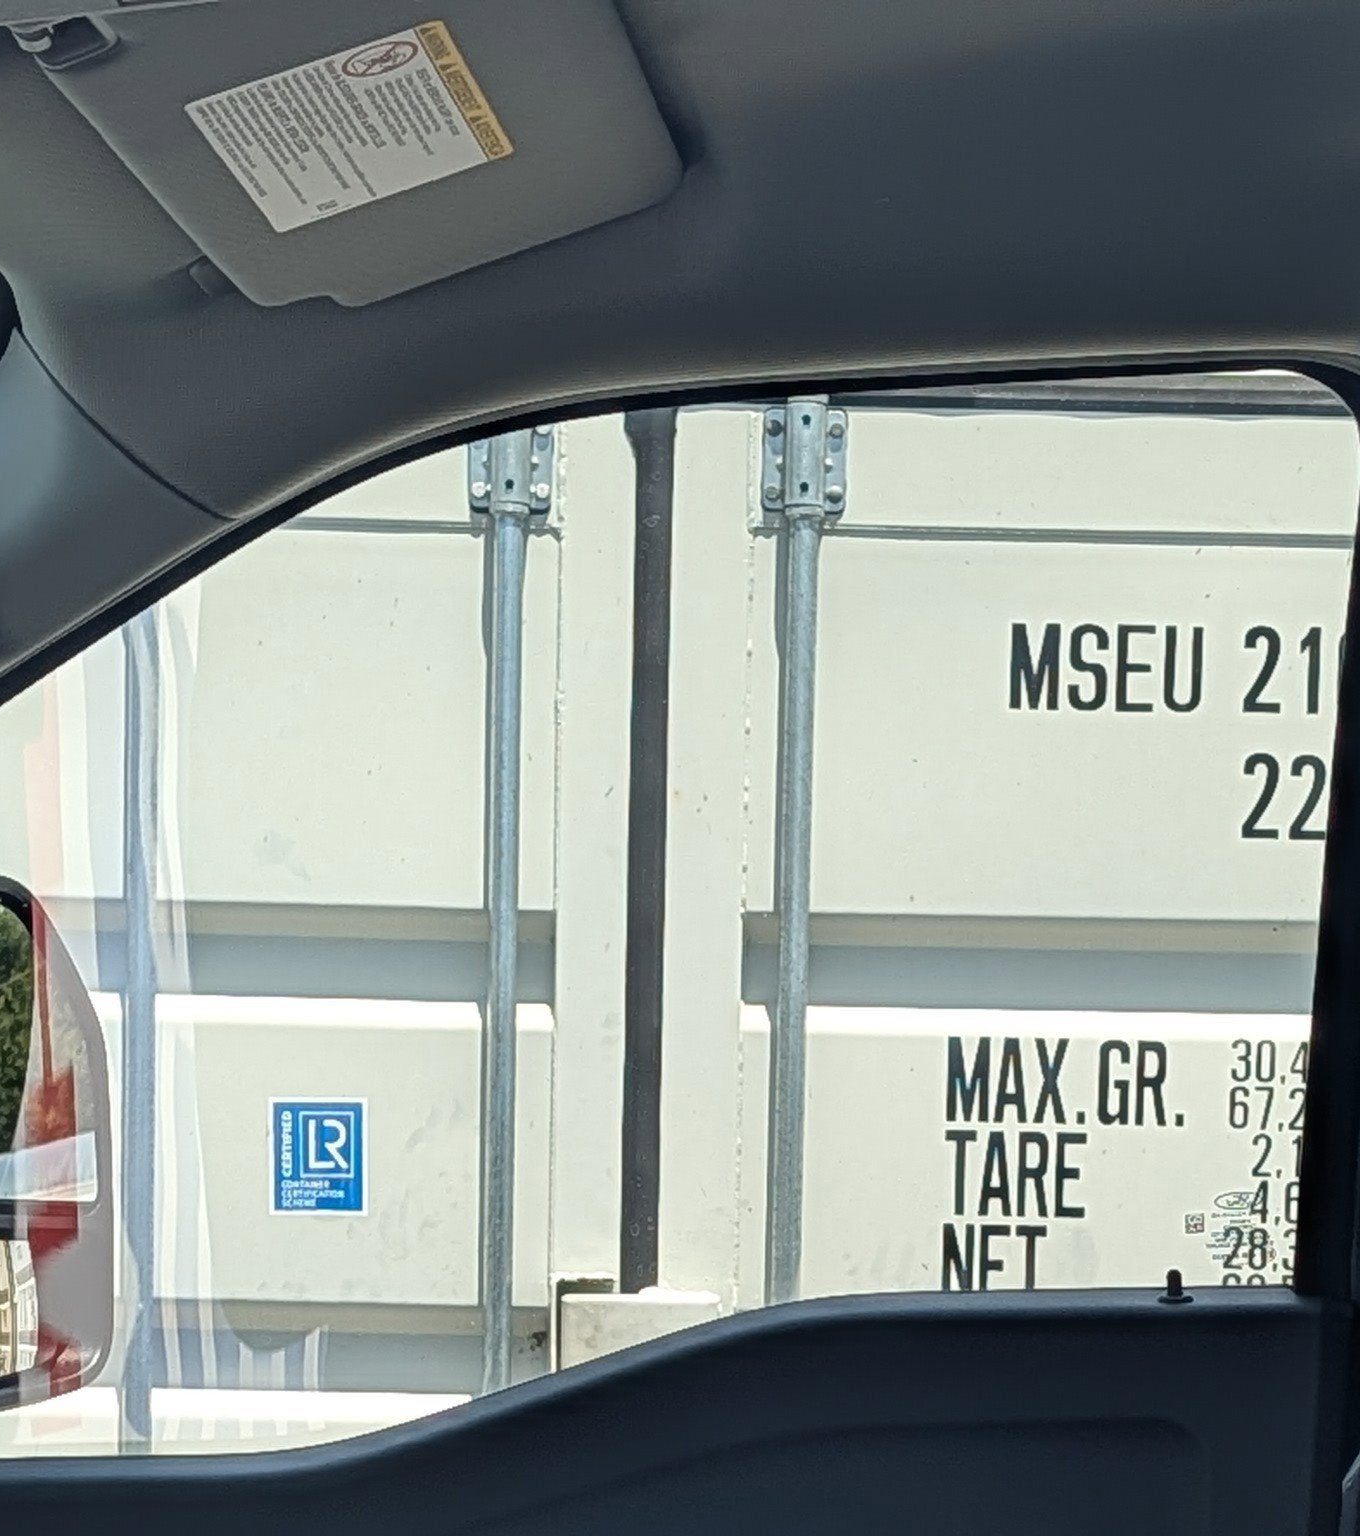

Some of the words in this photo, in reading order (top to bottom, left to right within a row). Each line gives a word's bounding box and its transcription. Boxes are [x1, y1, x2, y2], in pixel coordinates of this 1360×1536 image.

[1008, 622, 1205, 714] MSEU
[1242, 625, 1346, 715] 21
[1240, 752, 1327, 842] 22
[307, 1118, 350, 1170] LR
[944, 1129, 1088, 1220] TARE
